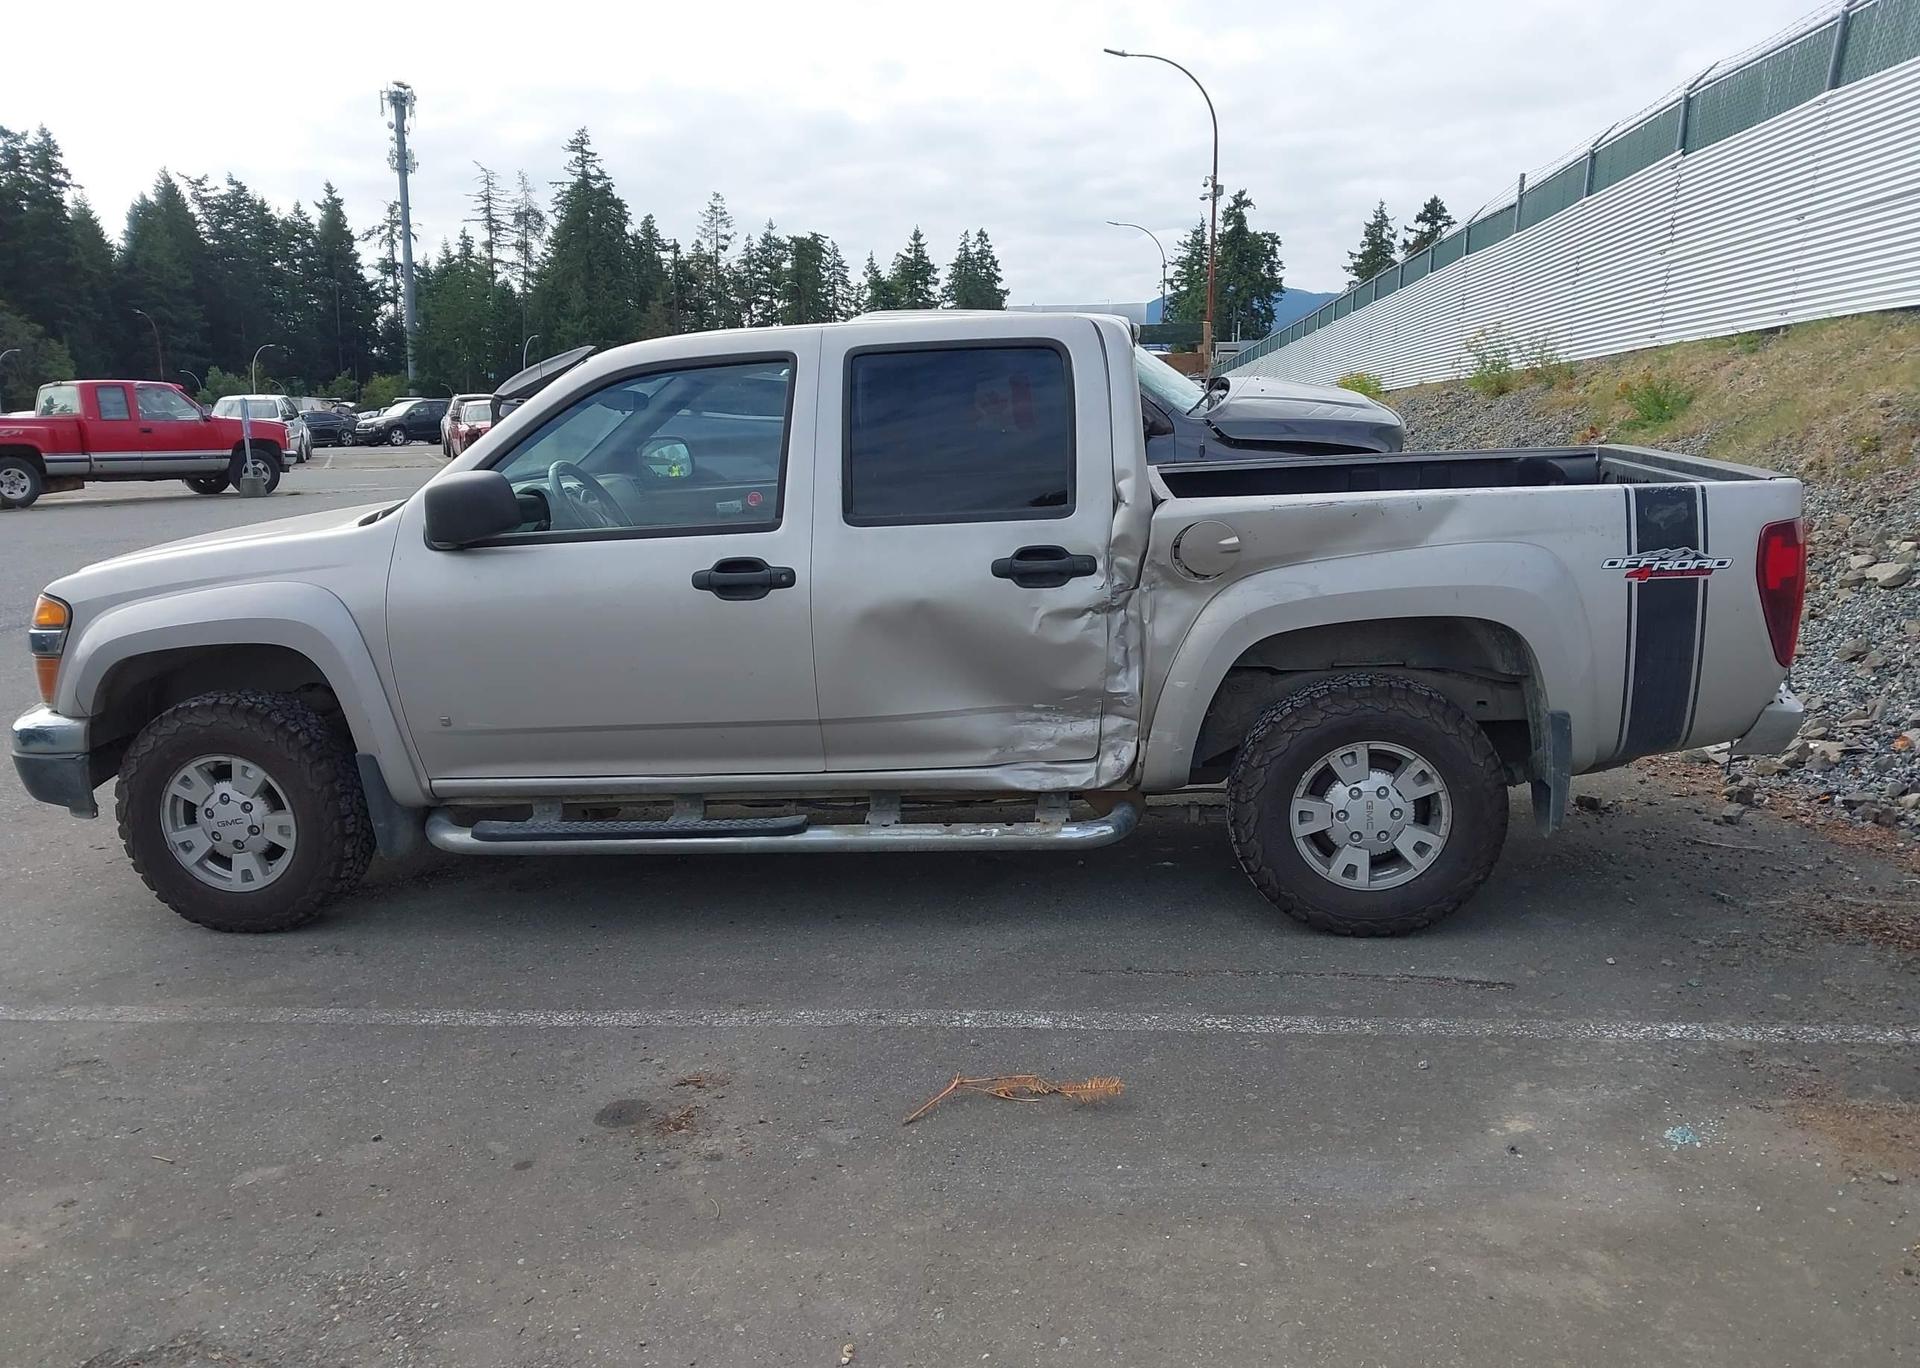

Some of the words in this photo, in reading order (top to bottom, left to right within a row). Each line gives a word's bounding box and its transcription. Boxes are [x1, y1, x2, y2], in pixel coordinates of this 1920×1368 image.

[1625, 567, 1649, 581] 4
[1366, 800, 1374, 830] GMC
[217, 818, 243, 827] GMC
